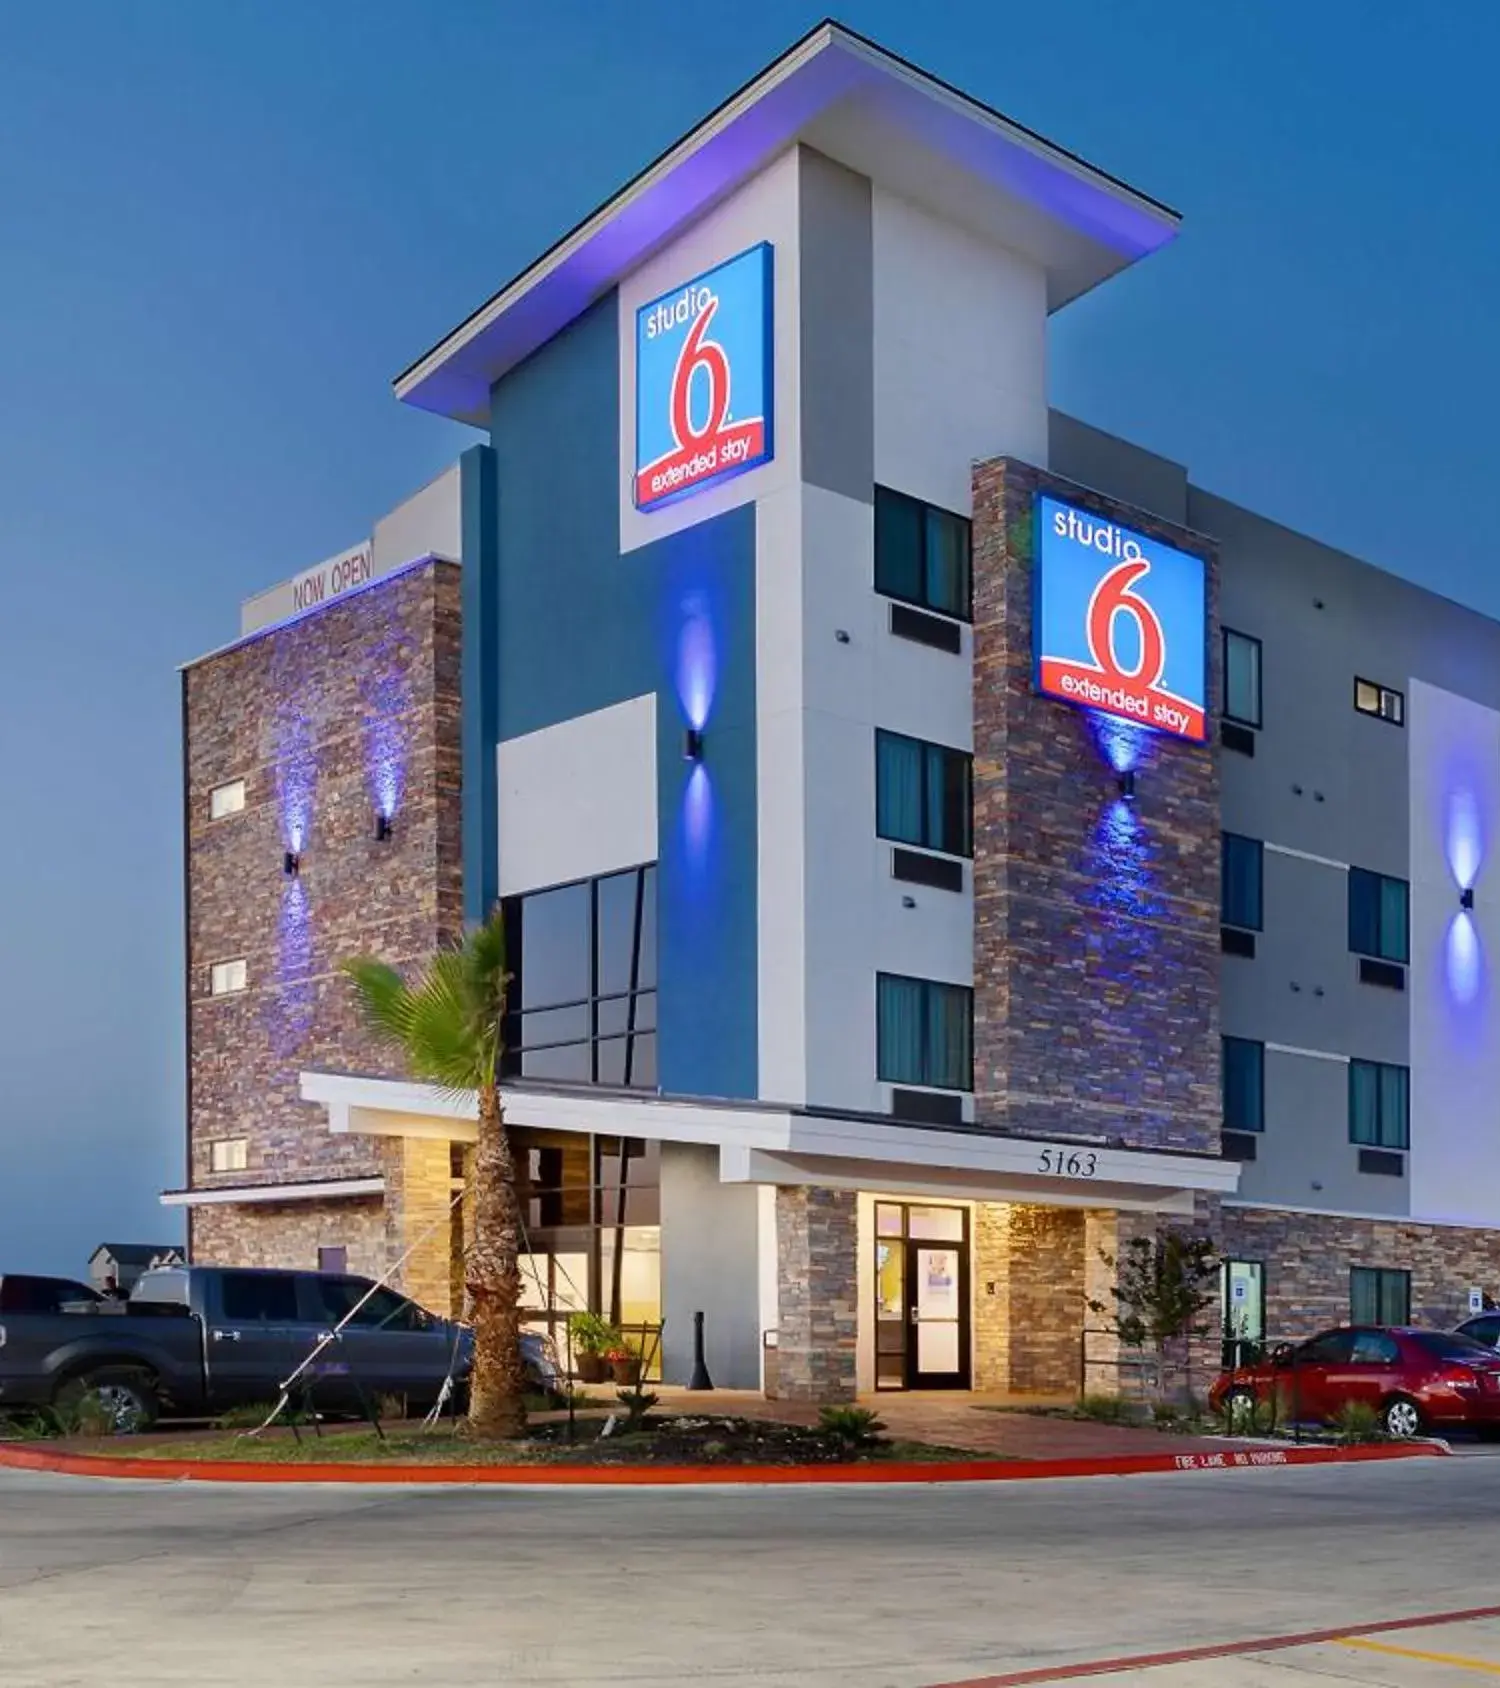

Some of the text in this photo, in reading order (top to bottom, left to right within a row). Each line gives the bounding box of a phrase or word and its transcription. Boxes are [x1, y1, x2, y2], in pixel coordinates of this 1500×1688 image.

[647, 287, 711, 339] studio
[670, 296, 732, 448] 6
[651, 435, 752, 493] extended stay
[1055, 510, 1142, 561] studio
[294, 549, 370, 611] NOW OPEN
[1087, 557, 1165, 688] 6
[1061, 672, 1190, 735] extended stay
[1037, 1148, 1097, 1177] 5163
[1175, 1455, 1198, 1469] FIRE
